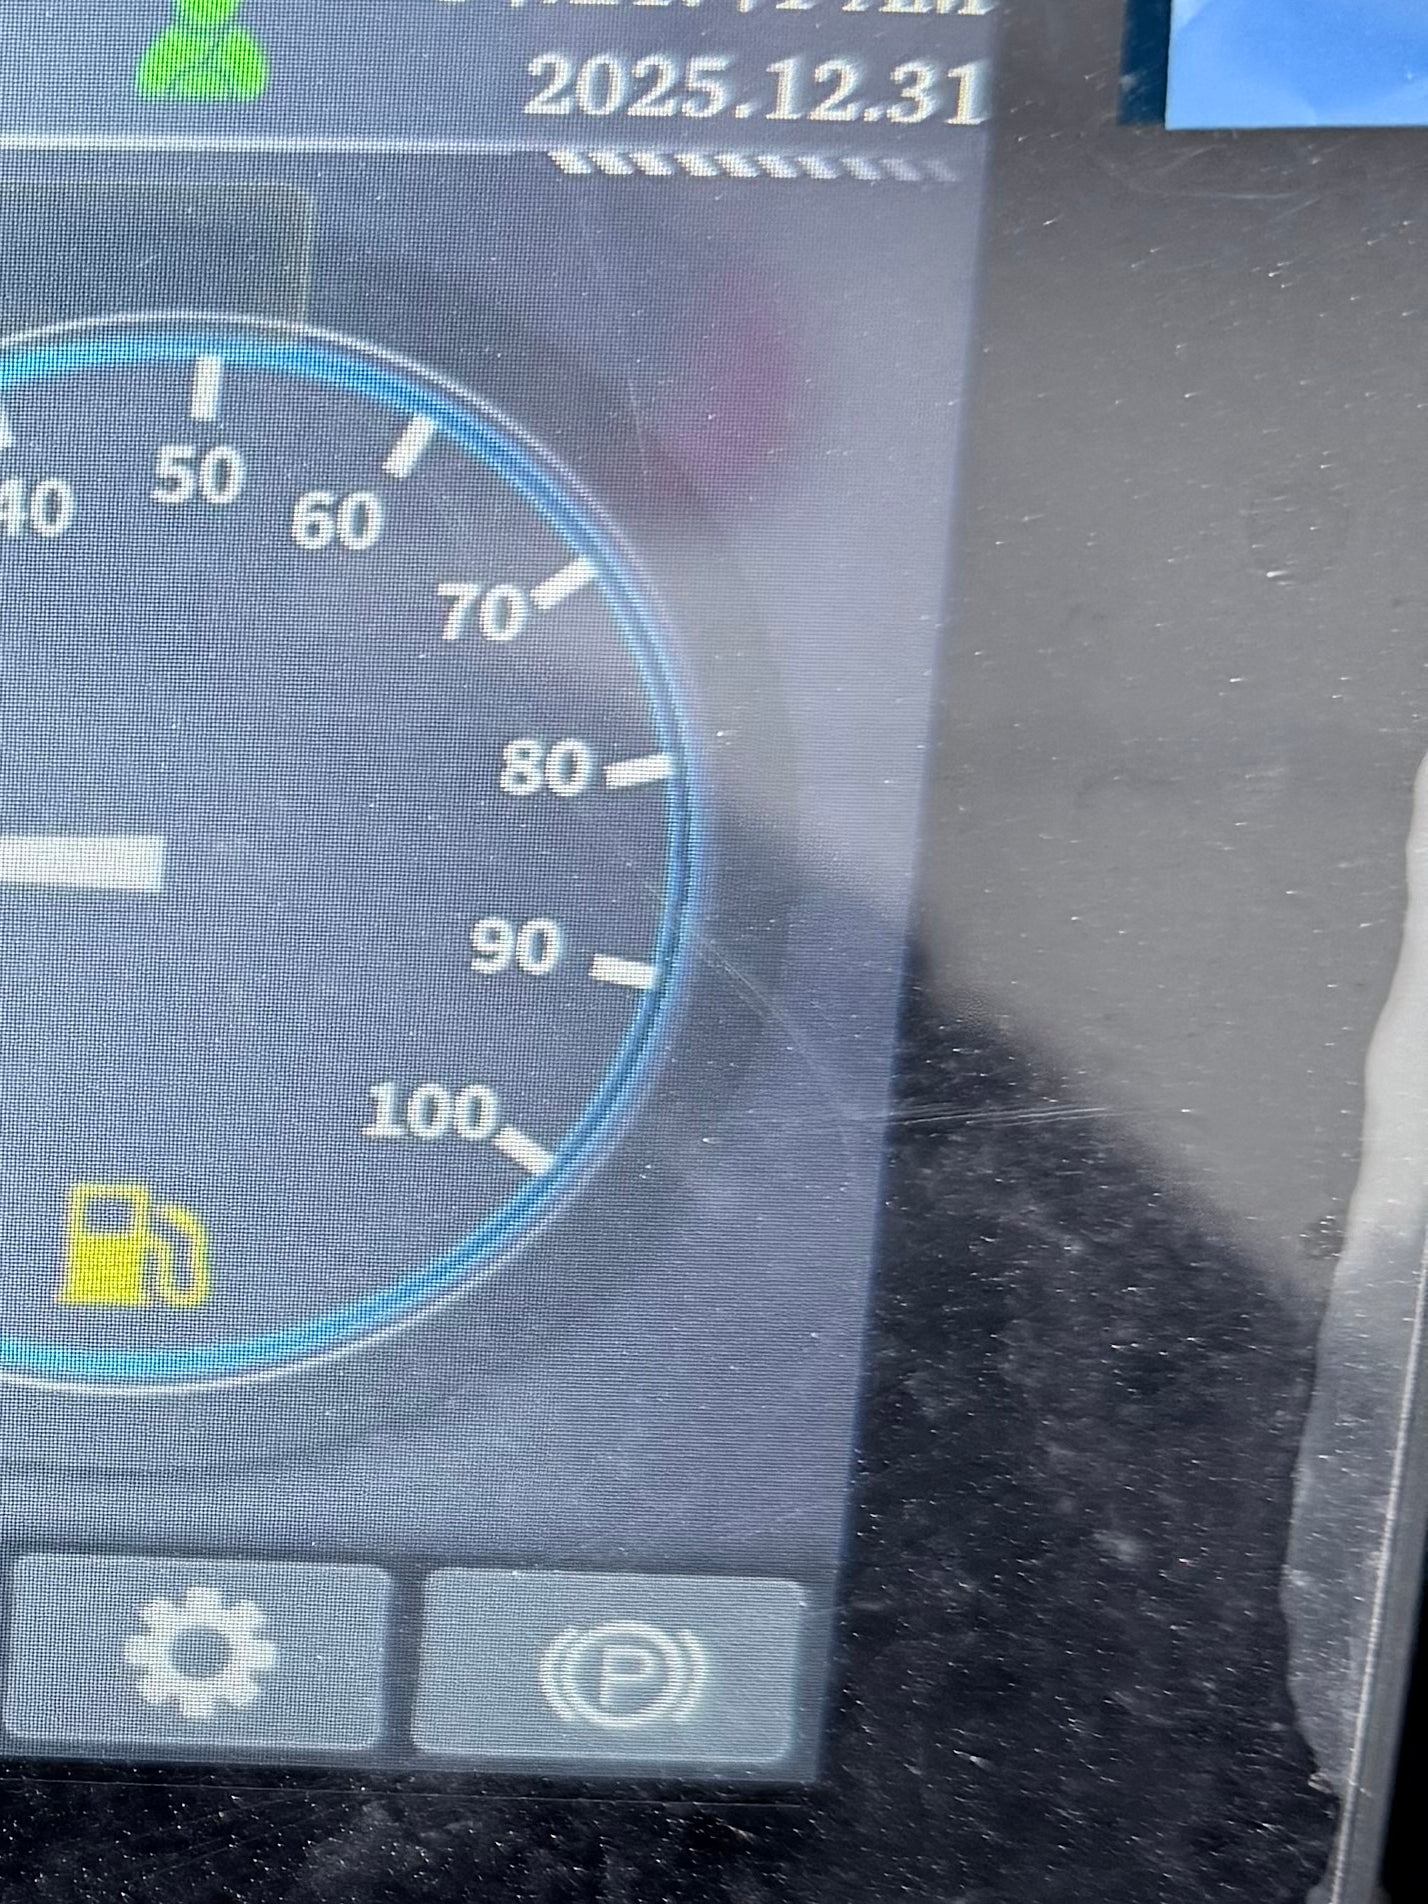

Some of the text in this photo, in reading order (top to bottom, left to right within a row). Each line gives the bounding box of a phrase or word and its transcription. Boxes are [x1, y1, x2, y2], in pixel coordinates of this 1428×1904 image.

[524, 53, 989, 126] 2025.12.31
[150, 445, 244, 506] 50
[291, 489, 382, 550] 60
[435, 583, 527, 642] 70
[499, 739, 590, 798] 80
[470, 919, 562, 979] 90
[361, 1084, 498, 1143] 100
